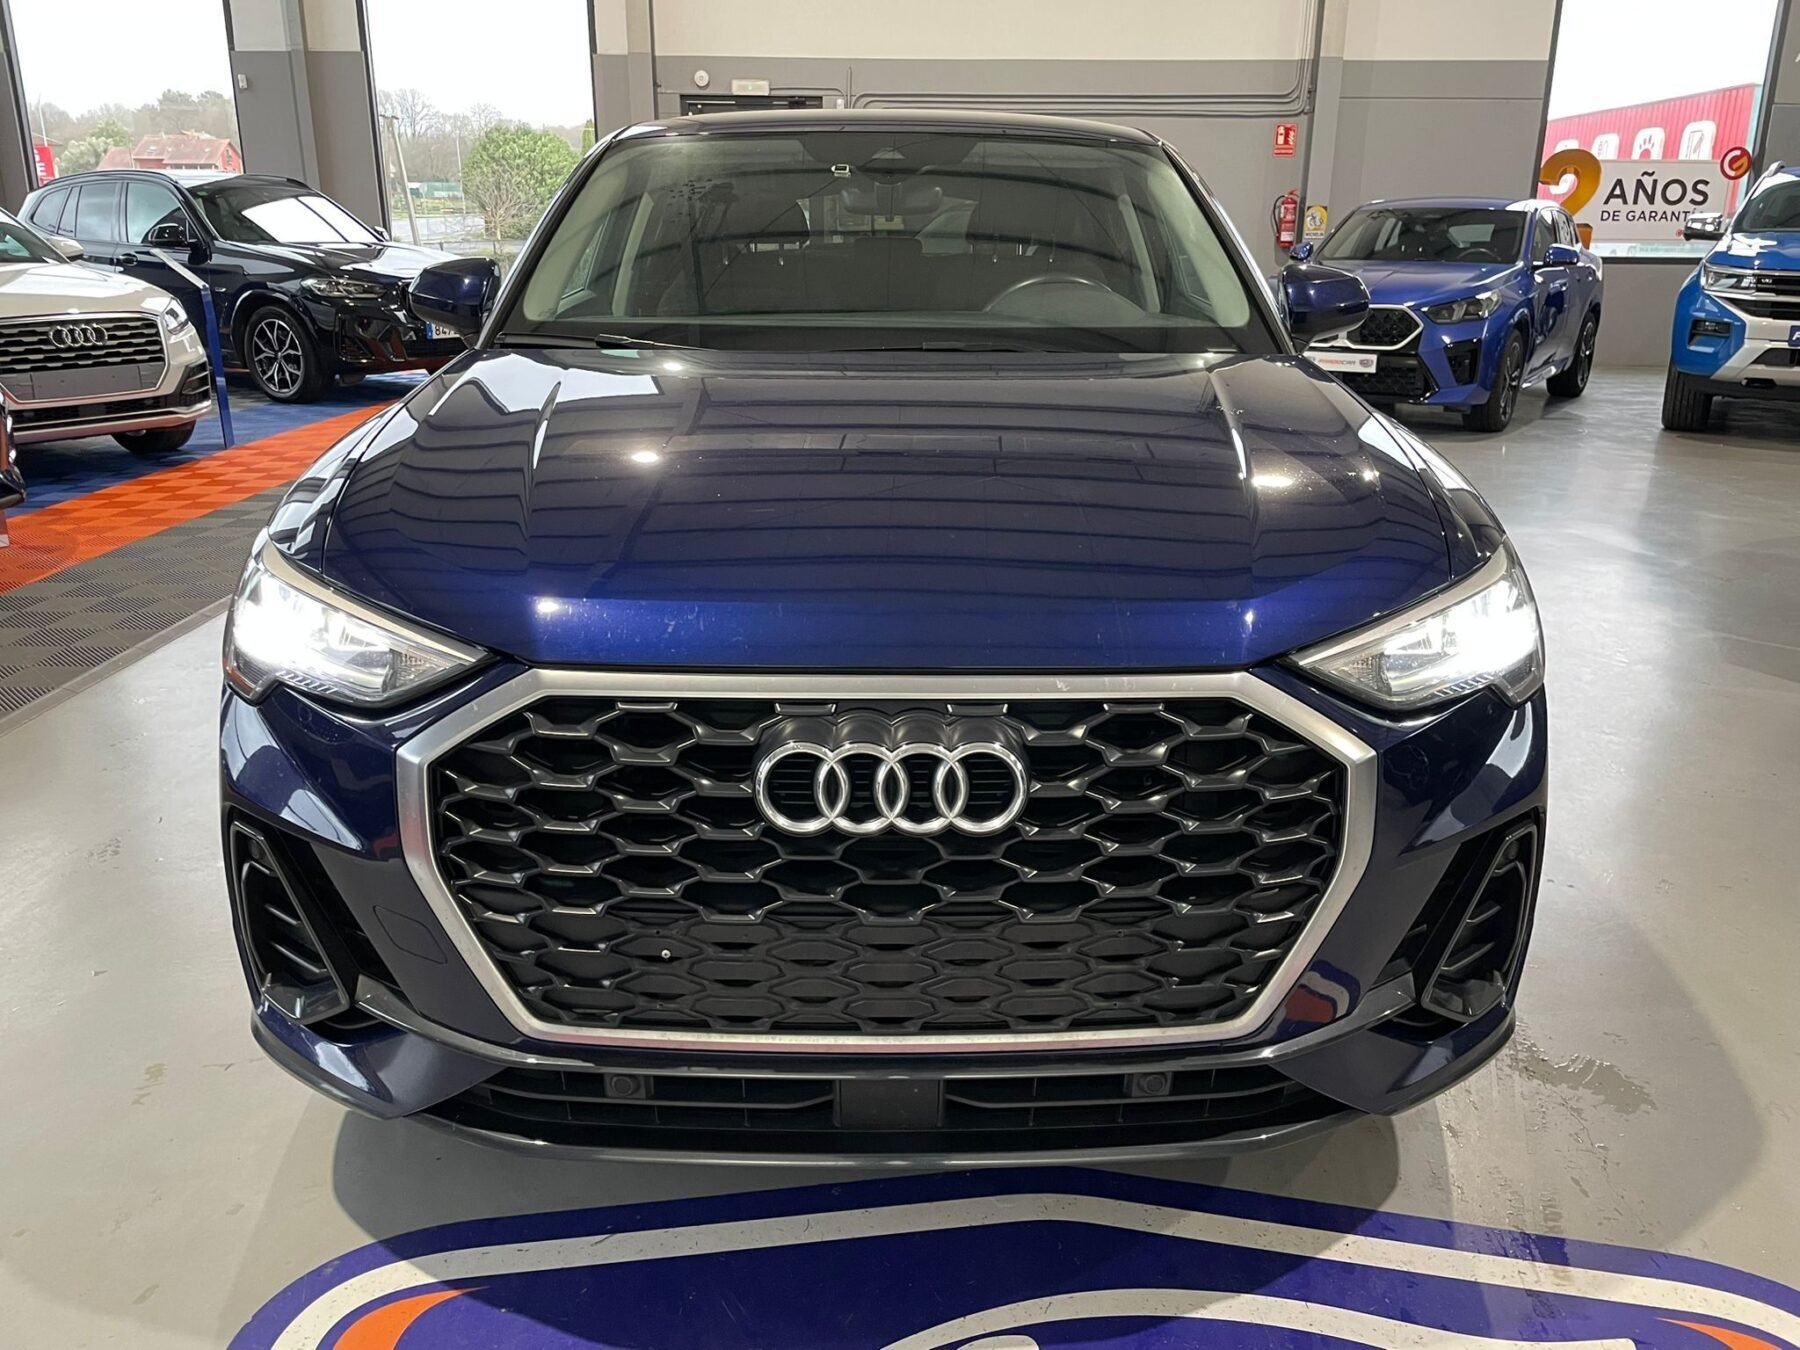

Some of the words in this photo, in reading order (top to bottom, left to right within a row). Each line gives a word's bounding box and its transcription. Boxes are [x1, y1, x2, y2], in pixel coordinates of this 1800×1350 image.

[1603, 170, 1710, 206] AÑOS
[1600, 210, 1621, 222] DE
[1626, 208, 1703, 223] GARANT
